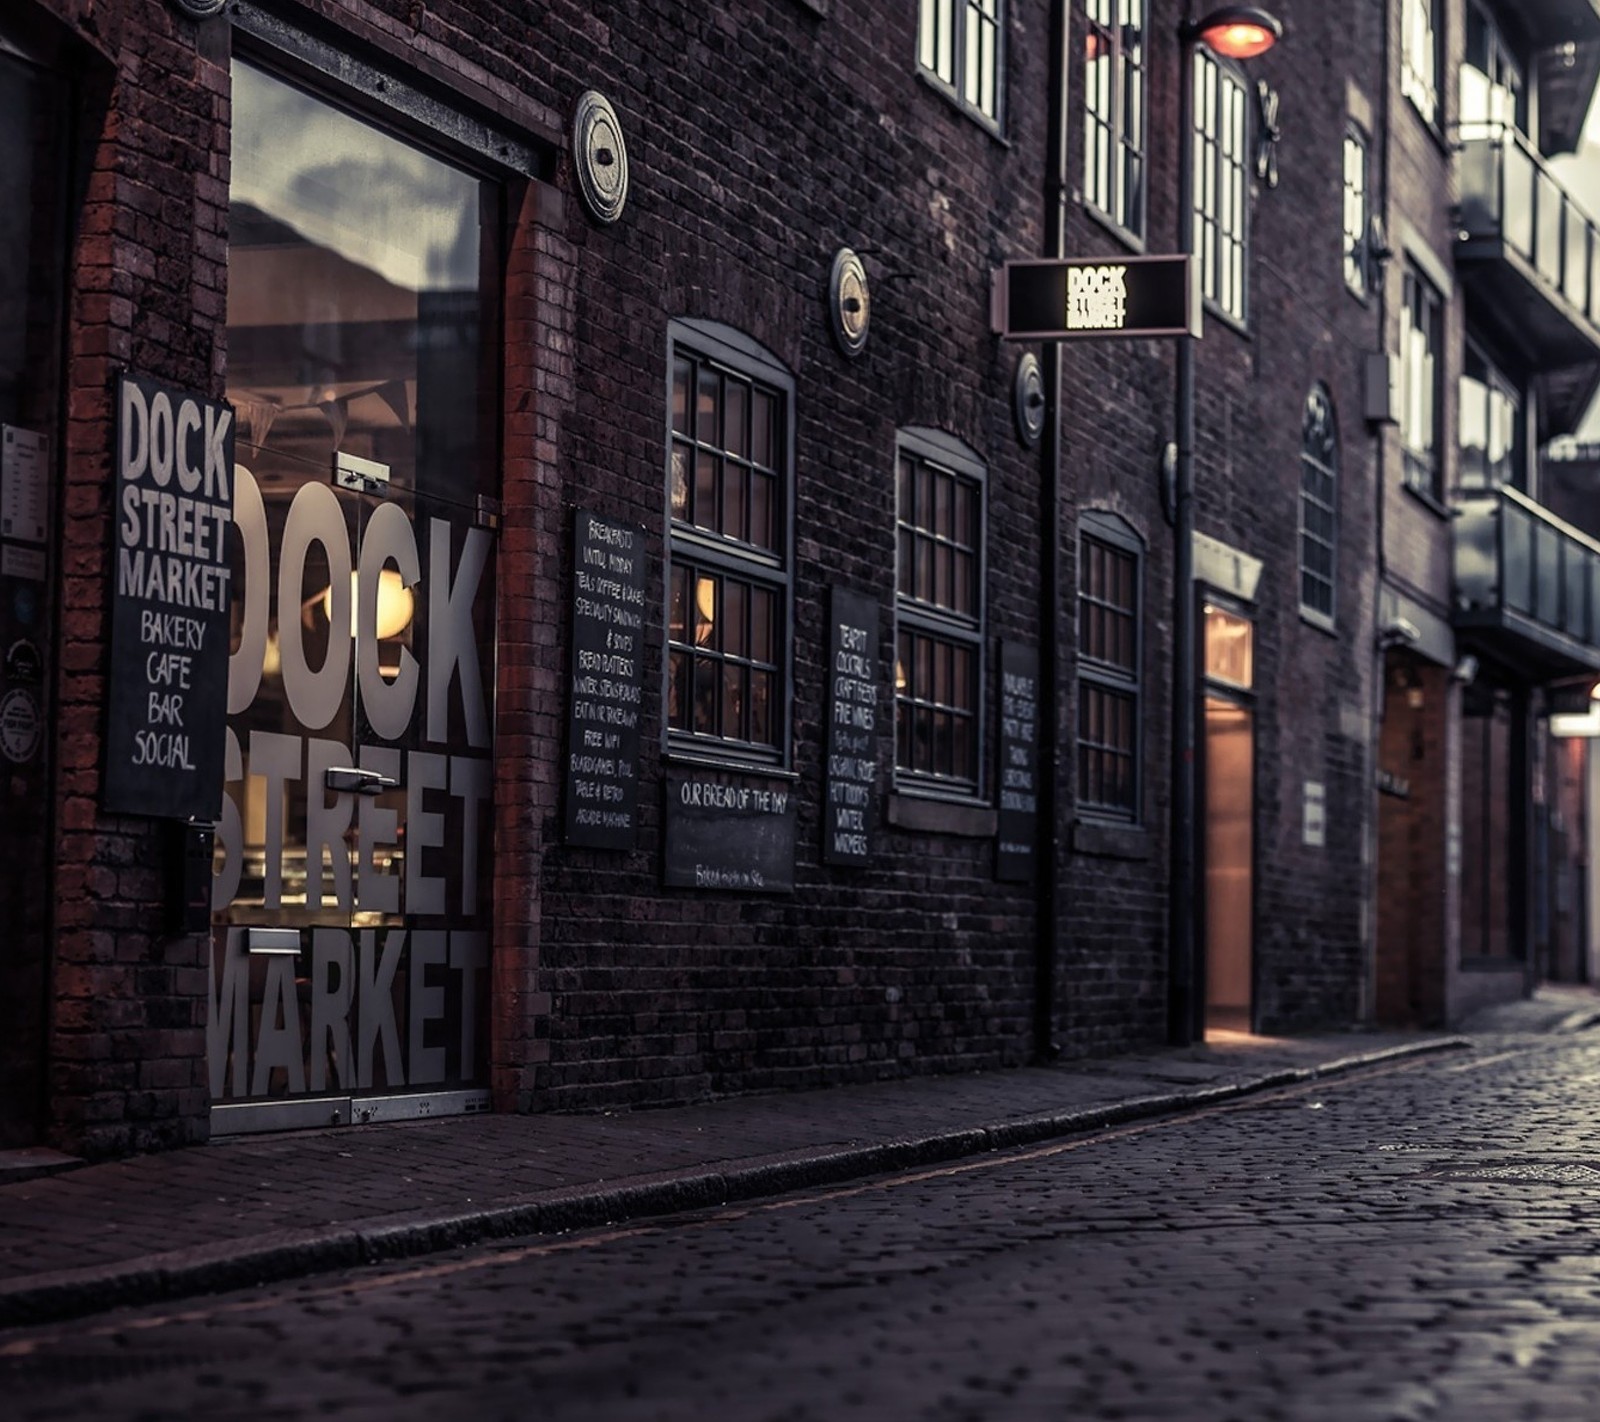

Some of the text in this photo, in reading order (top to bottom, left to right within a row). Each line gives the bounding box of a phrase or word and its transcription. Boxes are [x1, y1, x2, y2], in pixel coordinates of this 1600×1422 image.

[1067, 265, 1127, 298] DOCK
[121, 379, 231, 501] DOCK
[121, 484, 231, 563] STREET
[119, 548, 230, 612] MARKET
[576, 571, 595, 592] TEAS
[596, 577, 621, 599] COFFEE
[141, 610, 206, 650] BAKERY
[614, 633, 633, 652] SOUPS
[146, 651, 192, 690] CAFE
[579, 649, 601, 670] BREAD
[573, 674, 598, 695] WINTER
[148, 691, 184, 727] BAR
[132, 730, 196, 770] SOCIAL
[584, 729, 602, 747] FREE
[681, 782, 788, 814] OUR BREAD OF THE DAY
[206, 927, 489, 1098] MARKET
